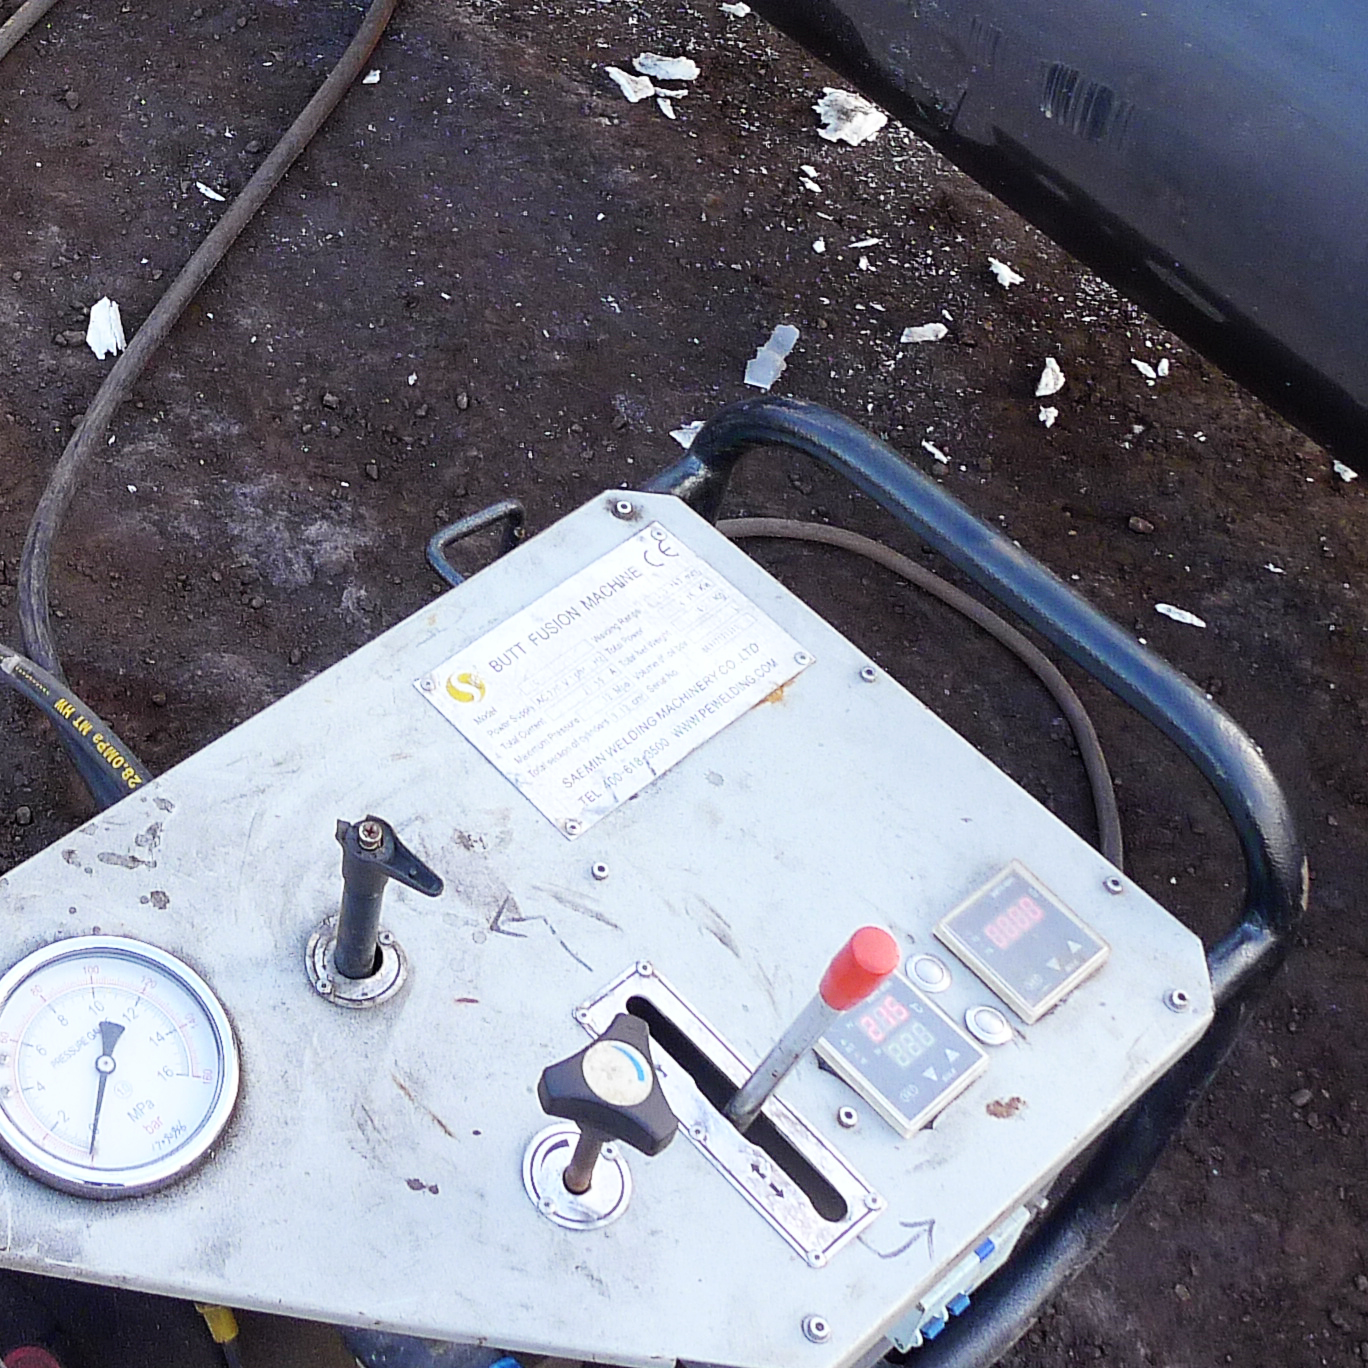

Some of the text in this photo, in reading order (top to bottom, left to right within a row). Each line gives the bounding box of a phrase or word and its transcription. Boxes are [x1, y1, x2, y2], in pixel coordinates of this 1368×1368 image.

[489, 641, 527, 674] BUTT
[529, 605, 581, 647] FUSION
[581, 563, 643, 612] MACHINE
[72, 714, 94, 736] MT
[561, 752, 608, 789] SAEMIN
[605, 716, 658, 757] WELDING
[655, 671, 719, 722] MACHINERY
[88, 1001, 104, 1015] 10
[122, 1006, 139, 1023] 12
[58, 1015, 68, 1026] 8
[149, 1031, 165, 1047] 14
[36, 1044, 47, 1056] 6
[52, 1038, 89, 1068] PRESSURE
[157, 1065, 174, 1081] 16
[37, 1081, 46, 1092] 4
[58, 1110, 70, 1123] 2
[127, 1098, 155, 1123] MPa
[143, 1115, 164, 1135] bar
